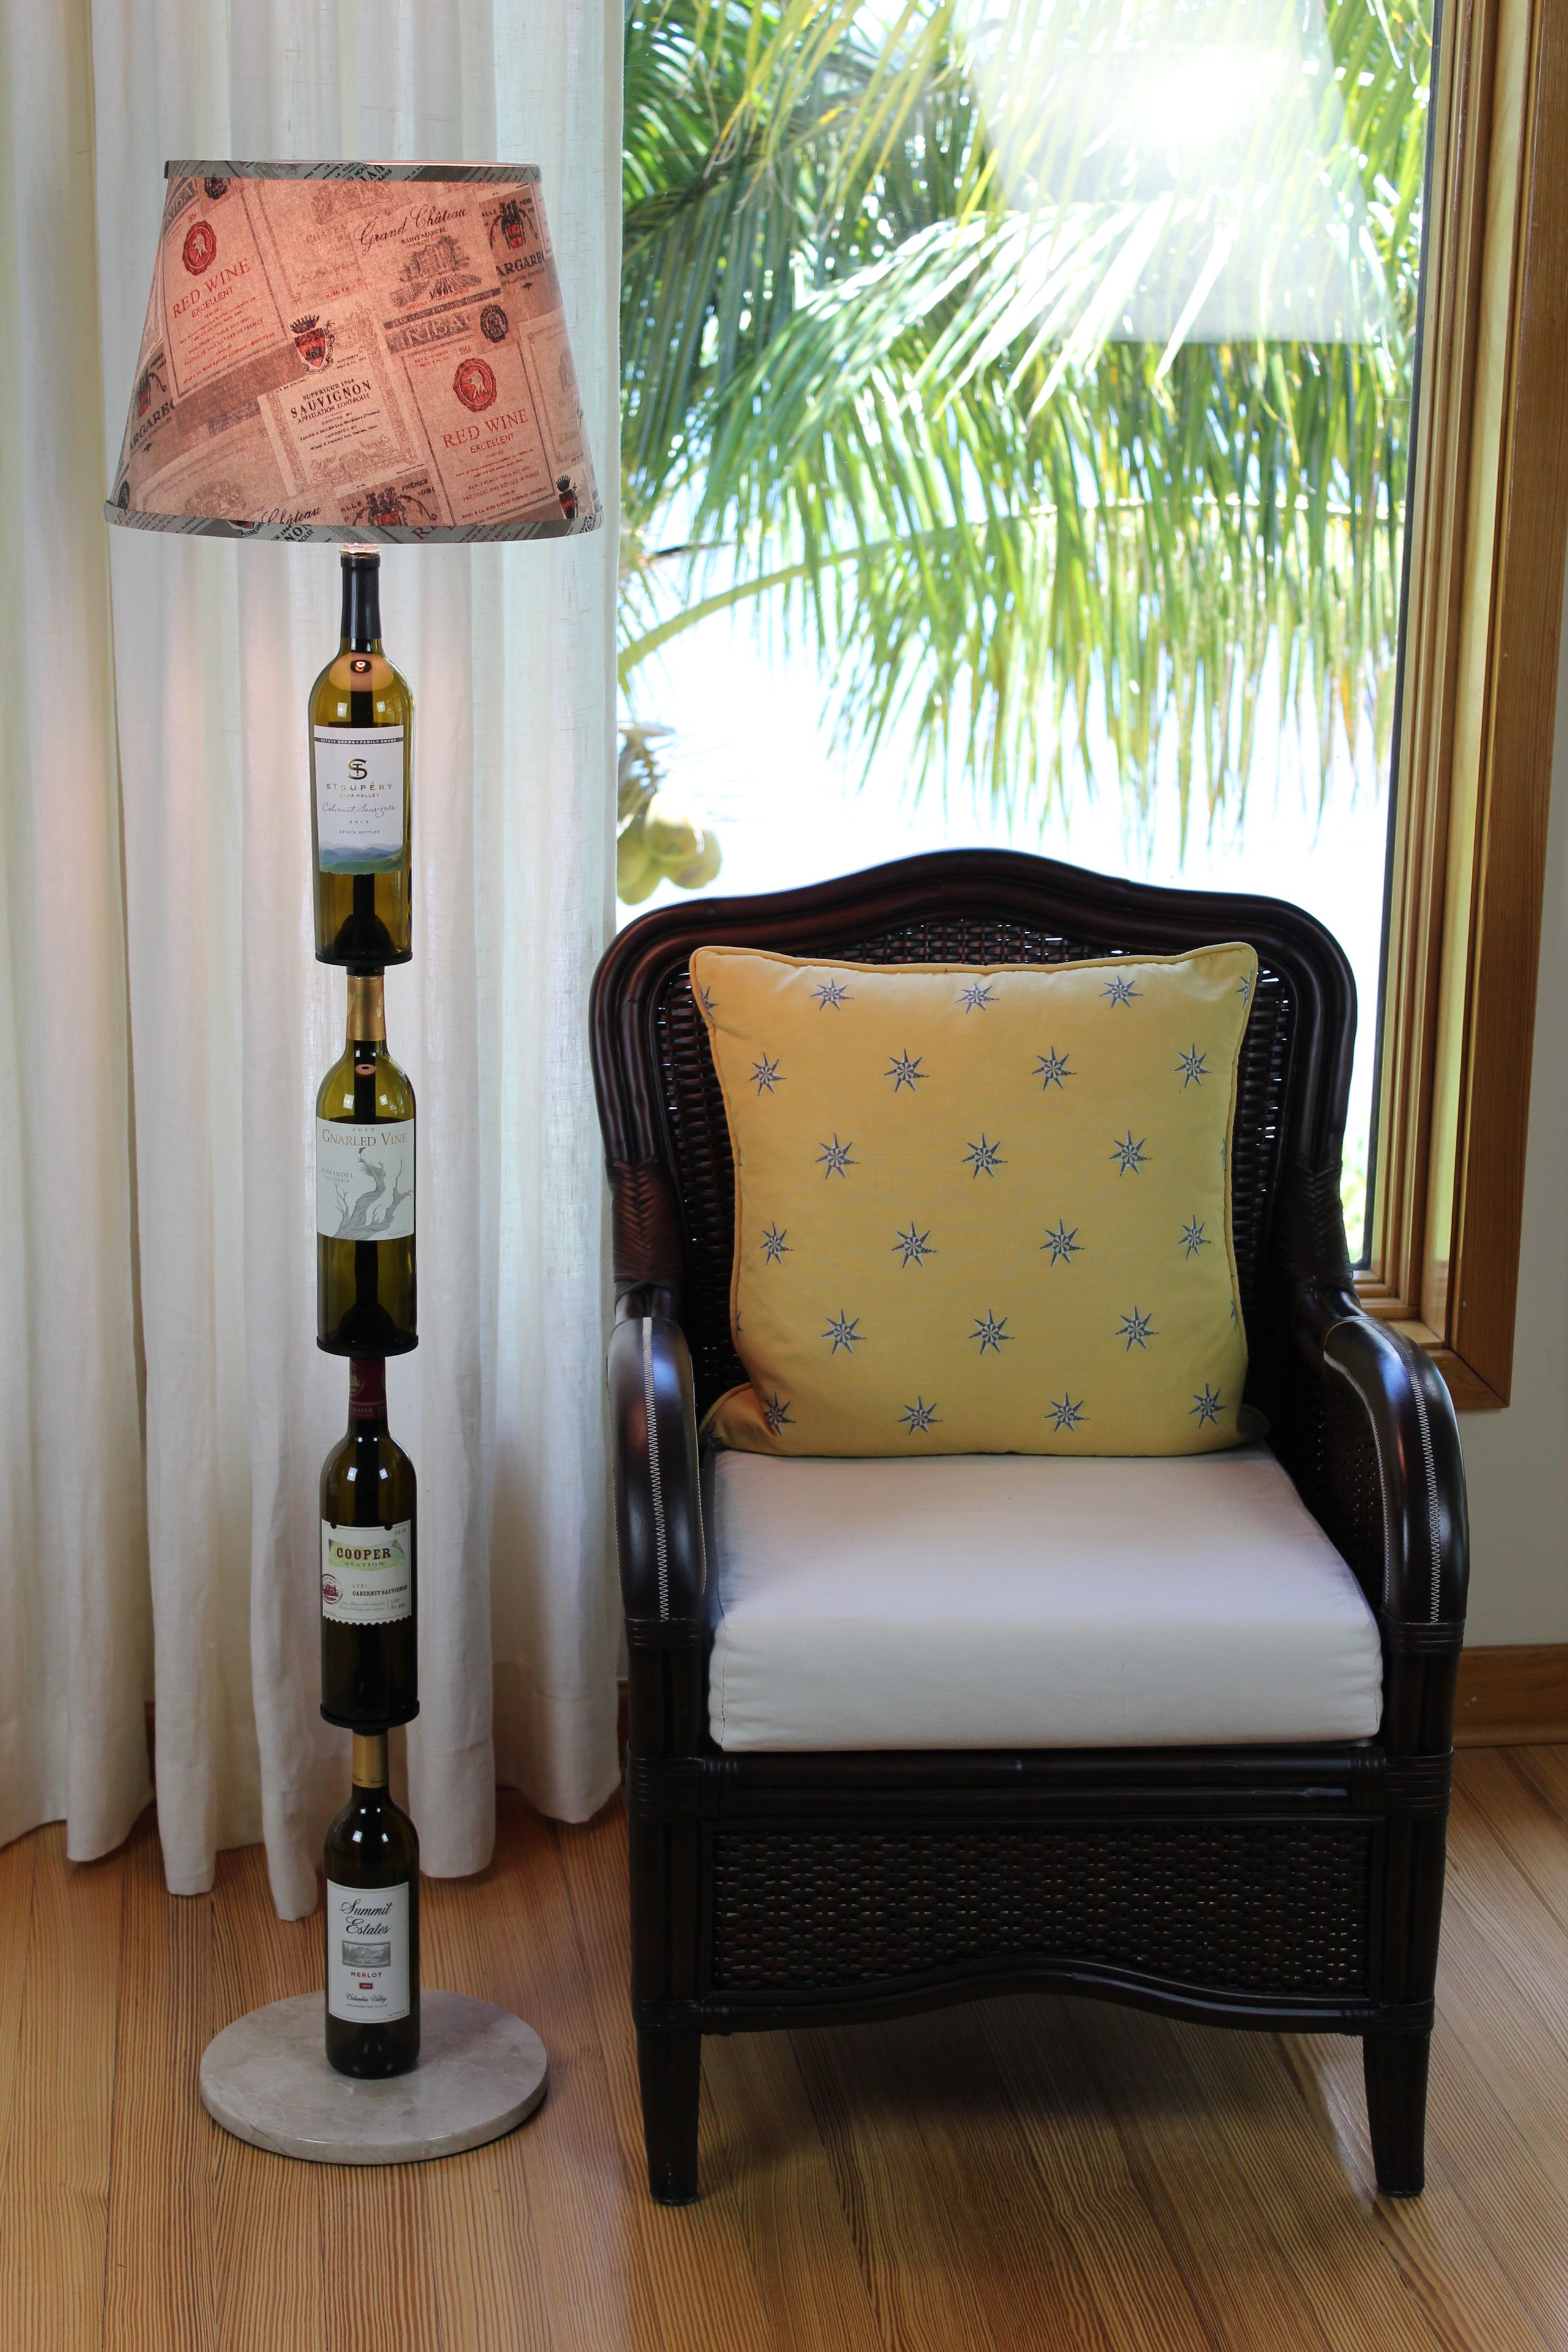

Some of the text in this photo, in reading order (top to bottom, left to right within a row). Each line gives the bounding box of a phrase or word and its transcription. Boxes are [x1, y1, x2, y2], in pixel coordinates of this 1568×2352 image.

[354, 216, 407, 255] Grand
[173, 290, 200, 318] RED
[205, 259, 251, 293] WINE
[191, 286, 233, 318] EXCELLENT
[290, 380, 371, 418] SAUVIGNON
[303, 378, 355, 400] SUPERIEUR 1964
[441, 409, 529, 448] RED WINE
[470, 432, 514, 453] EXCELLENT
[341, 782, 393, 791] SUPÉRY
[322, 1129, 407, 1147] GNARLED VINE
[321, 1167, 354, 1178] ZINFANDEL
[337, 1548, 391, 1560] COOPER
[381, 1585, 408, 1595] SAUVIGNON
[340, 1899, 393, 1917] Summit
[345, 1916, 391, 1936] Estates
